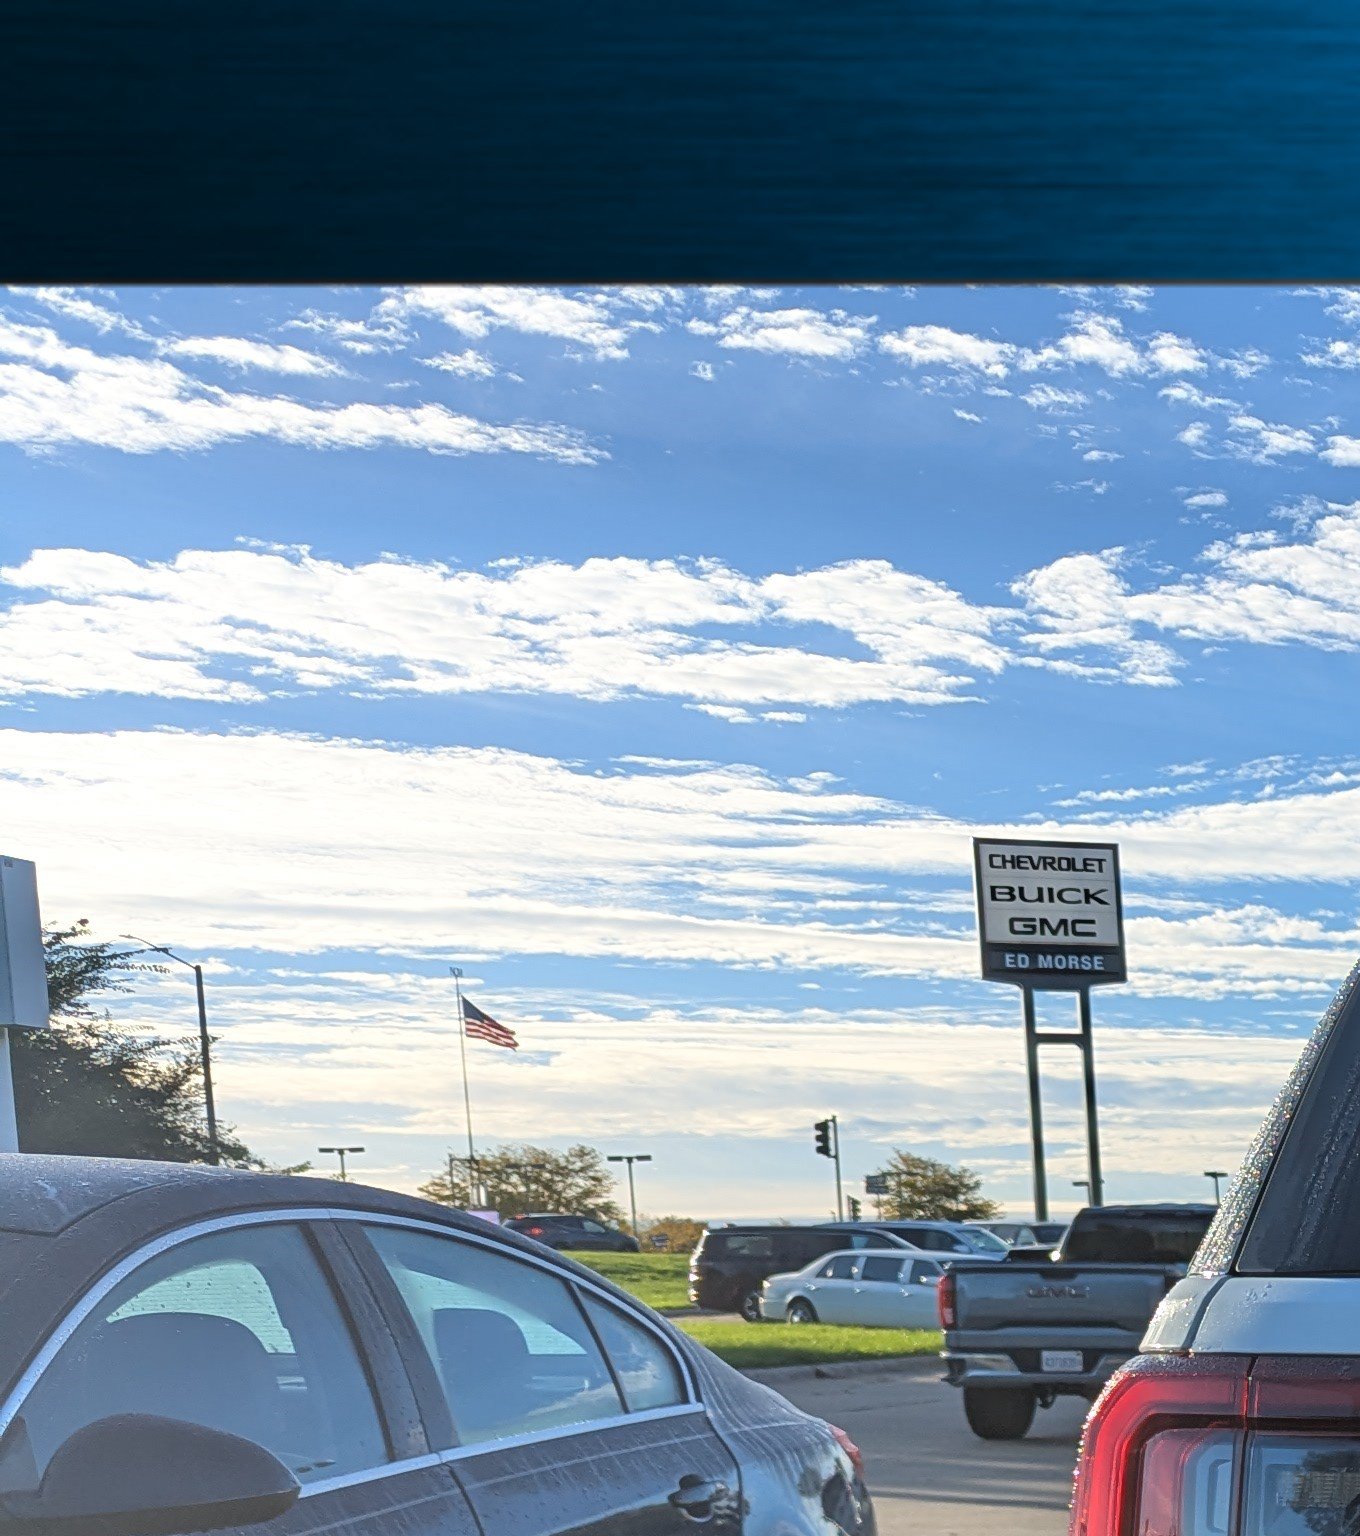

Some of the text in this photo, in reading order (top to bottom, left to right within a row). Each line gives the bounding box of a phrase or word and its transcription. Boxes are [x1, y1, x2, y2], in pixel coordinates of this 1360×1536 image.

[988, 854, 1106, 873] CHEVROLET
[990, 885, 1110, 905] BUICK
[1009, 917, 1097, 937] GMC
[1005, 953, 1105, 971] ED MORSE
